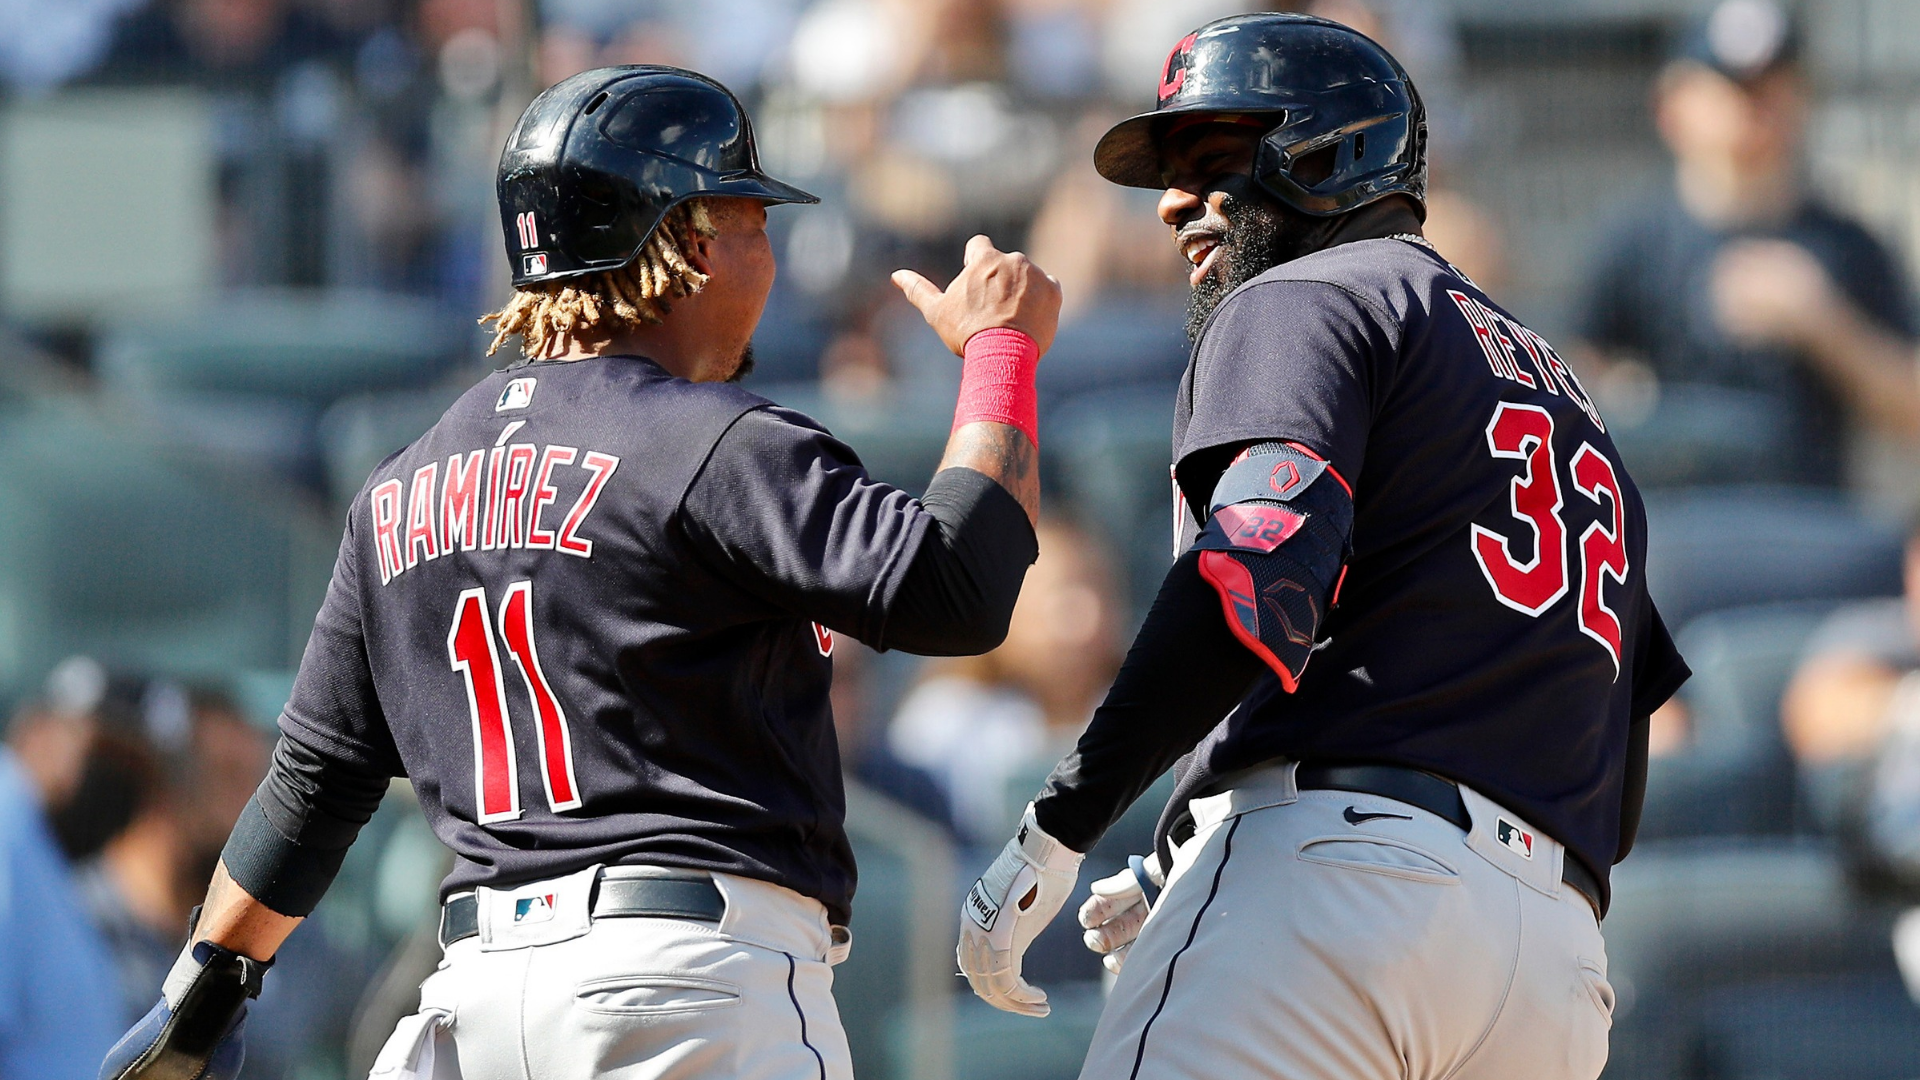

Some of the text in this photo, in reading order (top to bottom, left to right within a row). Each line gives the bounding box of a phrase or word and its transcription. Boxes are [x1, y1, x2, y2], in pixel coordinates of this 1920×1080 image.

[517, 211, 538, 249] 11
[371, 420, 620, 586] RAMÍREZ
[1240, 516, 1285, 542] 32
[1471, 401, 1629, 684] 32
[447, 580, 582, 825] 11
